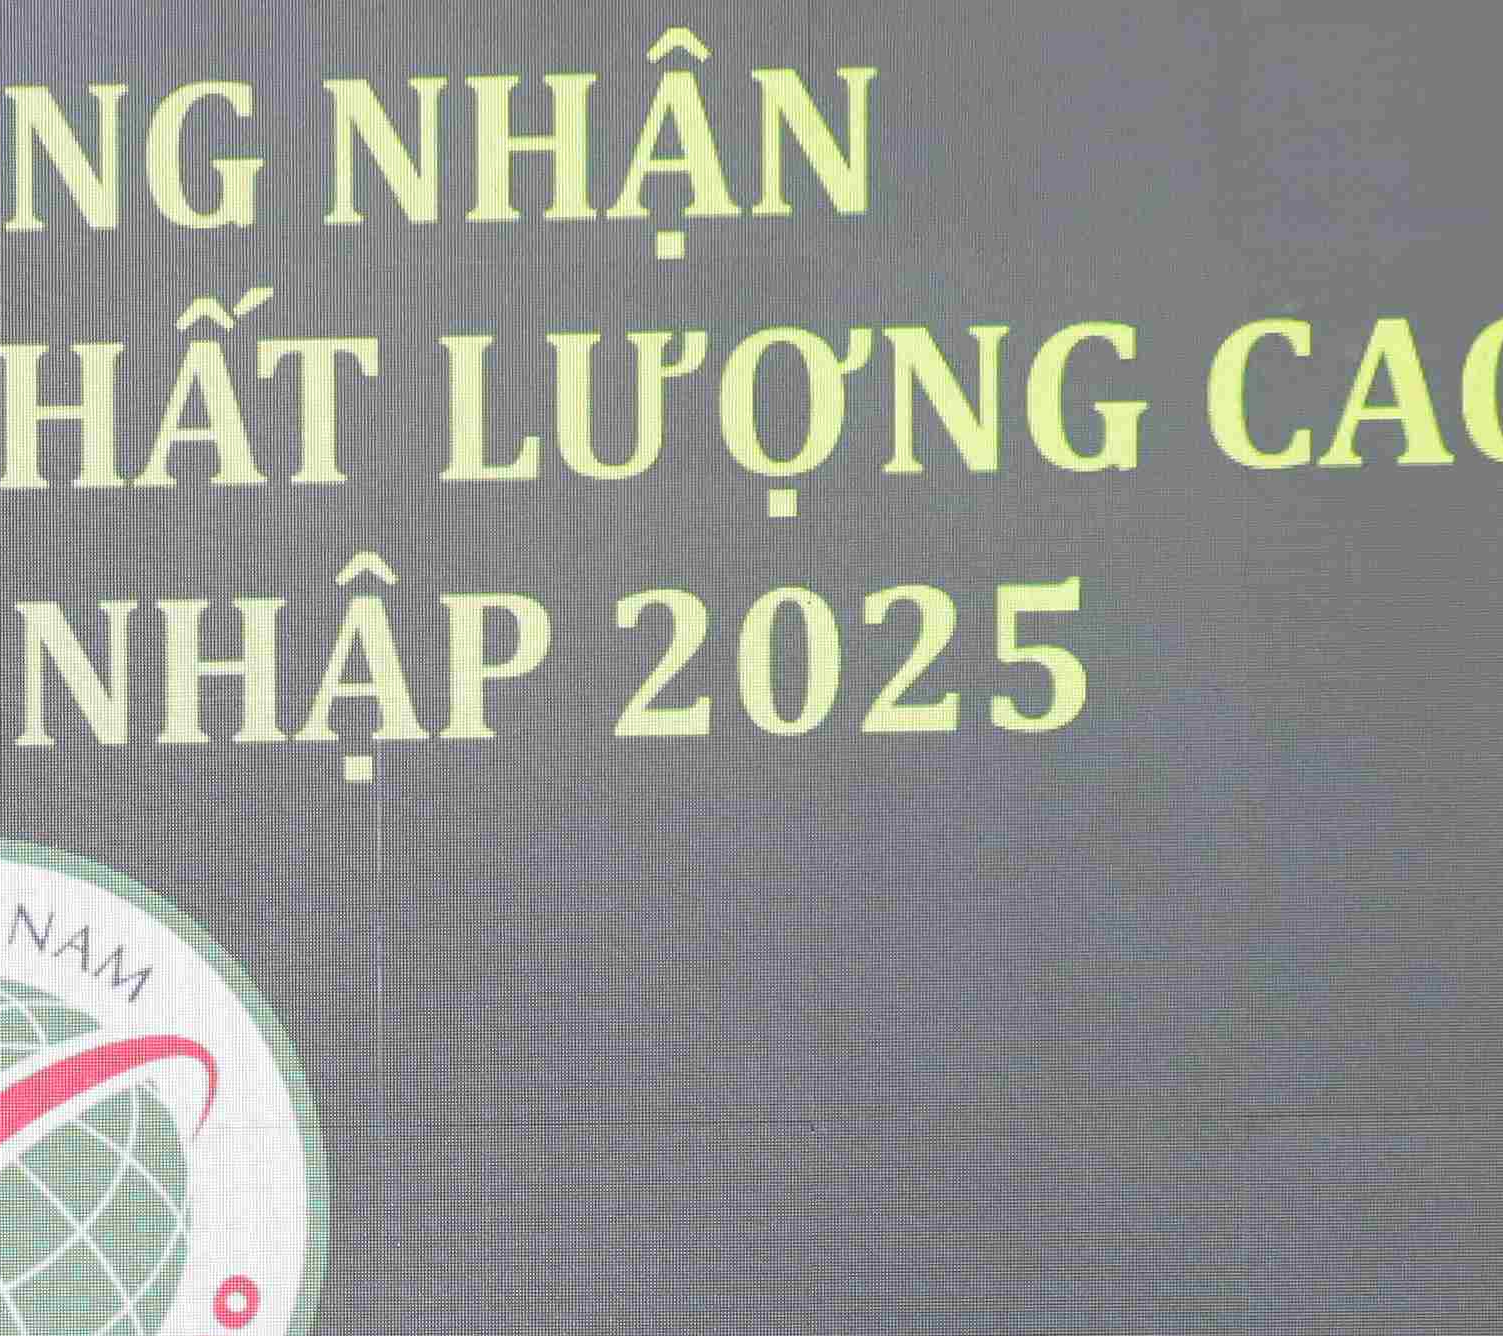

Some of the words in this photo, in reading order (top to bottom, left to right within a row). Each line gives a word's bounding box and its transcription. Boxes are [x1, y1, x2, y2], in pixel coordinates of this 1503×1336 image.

[325, 27, 877, 260] NHẬN
[439, 324, 1150, 519] LƯỢNG
[15, 553, 553, 783] NHẬP
[612, 577, 1090, 738] 2025
[6, 900, 157, 1004] NAM
